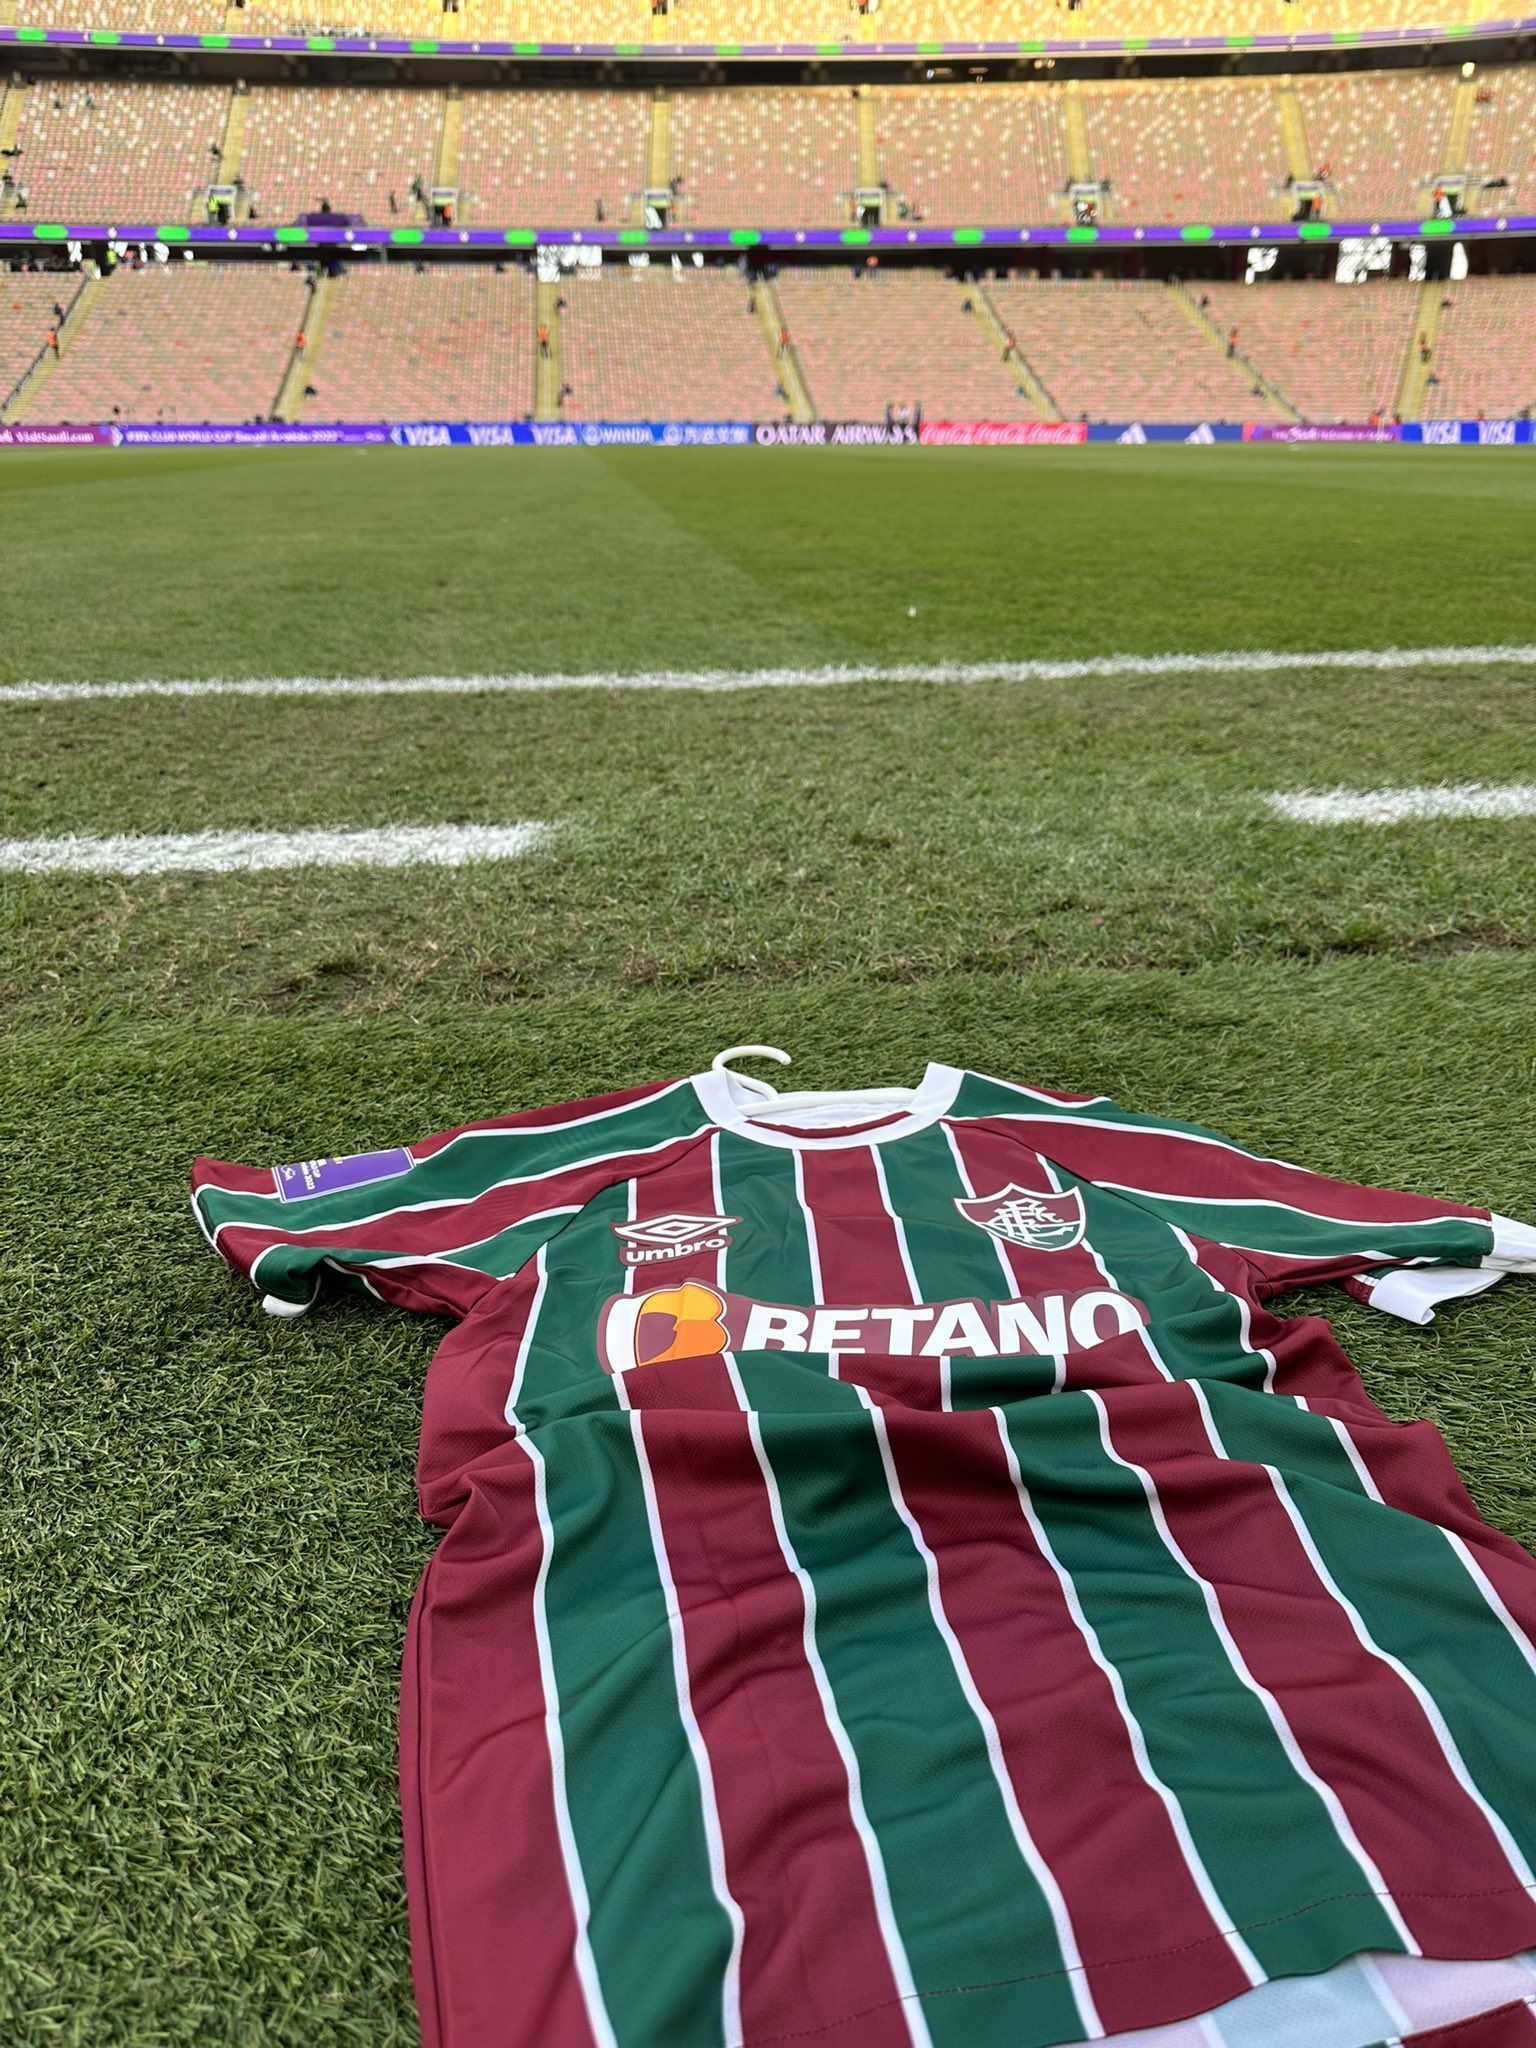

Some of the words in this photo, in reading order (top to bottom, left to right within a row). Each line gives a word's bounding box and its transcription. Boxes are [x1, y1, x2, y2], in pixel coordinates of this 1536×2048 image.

[404, 425, 451, 446] VISA
[467, 425, 514, 445] VISA
[530, 425, 578, 445] VISA
[755, 423, 826, 446] QATAR
[831, 423, 917, 446] AIRWAYS
[1422, 421, 1460, 445] VISA
[1479, 421, 1516, 445] VISA
[626, 1238, 725, 1262] umbro
[742, 1291, 1144, 1357] BETANO
